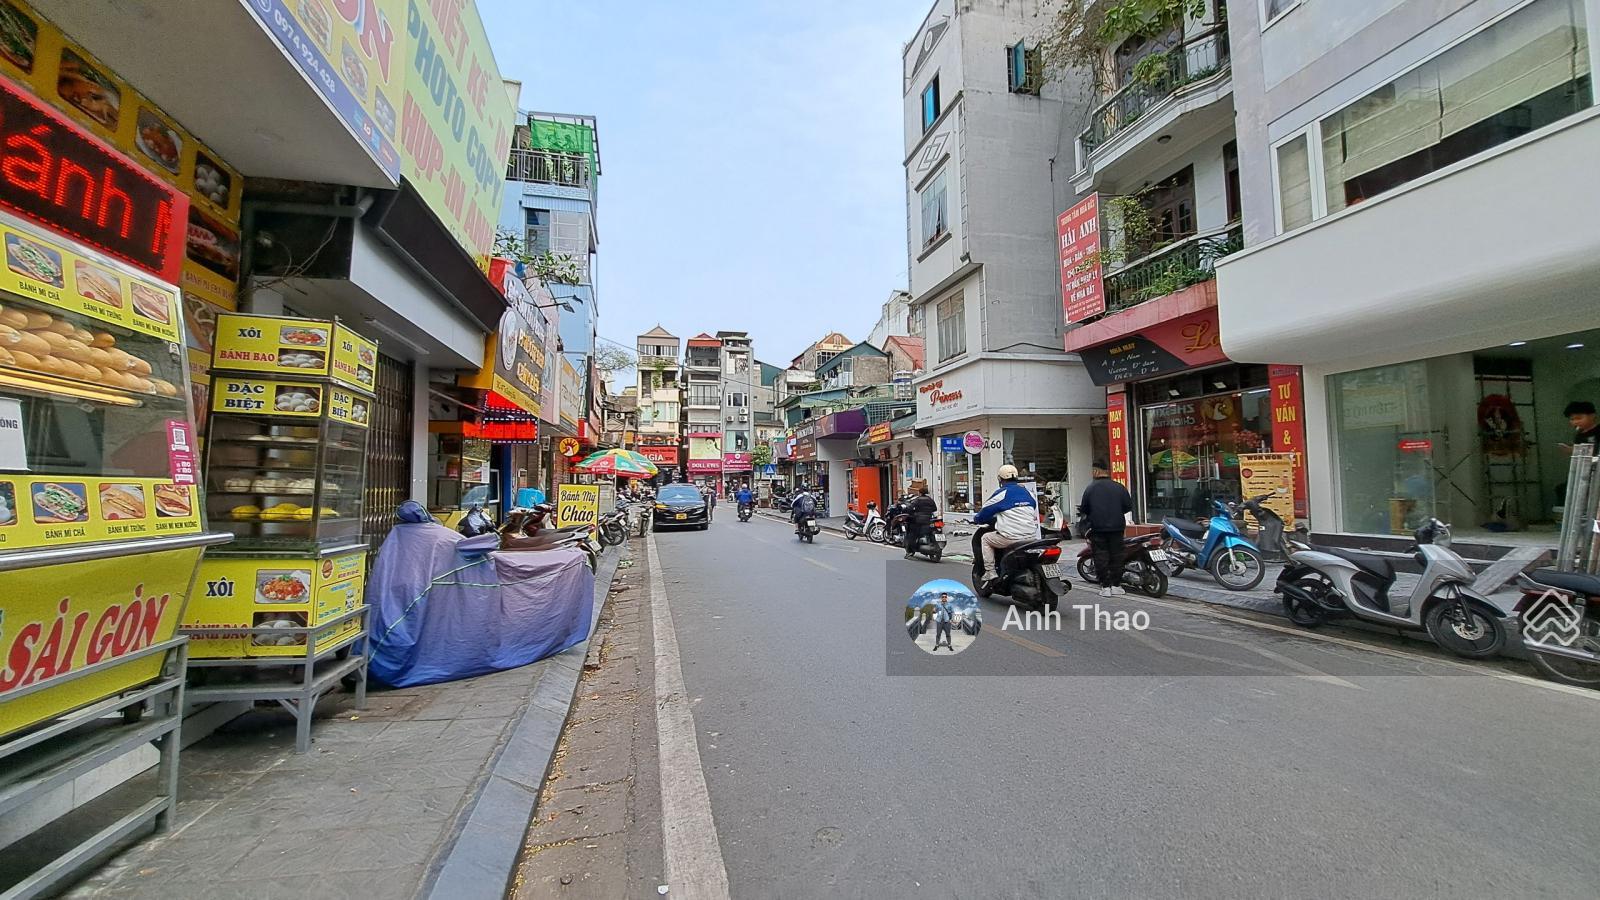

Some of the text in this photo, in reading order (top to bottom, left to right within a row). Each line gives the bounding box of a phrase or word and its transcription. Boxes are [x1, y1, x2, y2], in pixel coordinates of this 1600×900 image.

[406, 0, 501, 207] PHOTO COPY
[1061, 216, 1097, 249] HẢI ANH
[19, 281, 60, 301] BÁNH MÌ CHẢ
[83, 302, 98, 313] BÁNH
[98, 307, 106, 316] MÌ
[238, 327, 262, 339] XÔI
[342, 341, 353, 352] XÔI
[220, 349, 275, 362] BÁNH BAO
[334, 359, 357, 377] BÁNH BAO
[227, 382, 265, 396] ĐẶC
[1278, 382, 1291, 400] TƯ
[225, 397, 265, 411] BIỆT
[333, 391, 349, 404] ĐẶC
[331, 406, 349, 419] BIỆT
[1109, 410, 1122, 423] MAY
[1275, 402, 1296, 423] VẤN
[990, 440, 1002, 449] 60
[1283, 430, 1291, 445] &
[561, 490, 580, 502] Bánh
[561, 504, 596, 522] Chảo
[45, 527, 86, 539] BÁNH MÌ CHẢ
[107, 526, 121, 534] BÁNH
[122, 525, 129, 533] MÌ
[206, 577, 234, 598] XÔI
